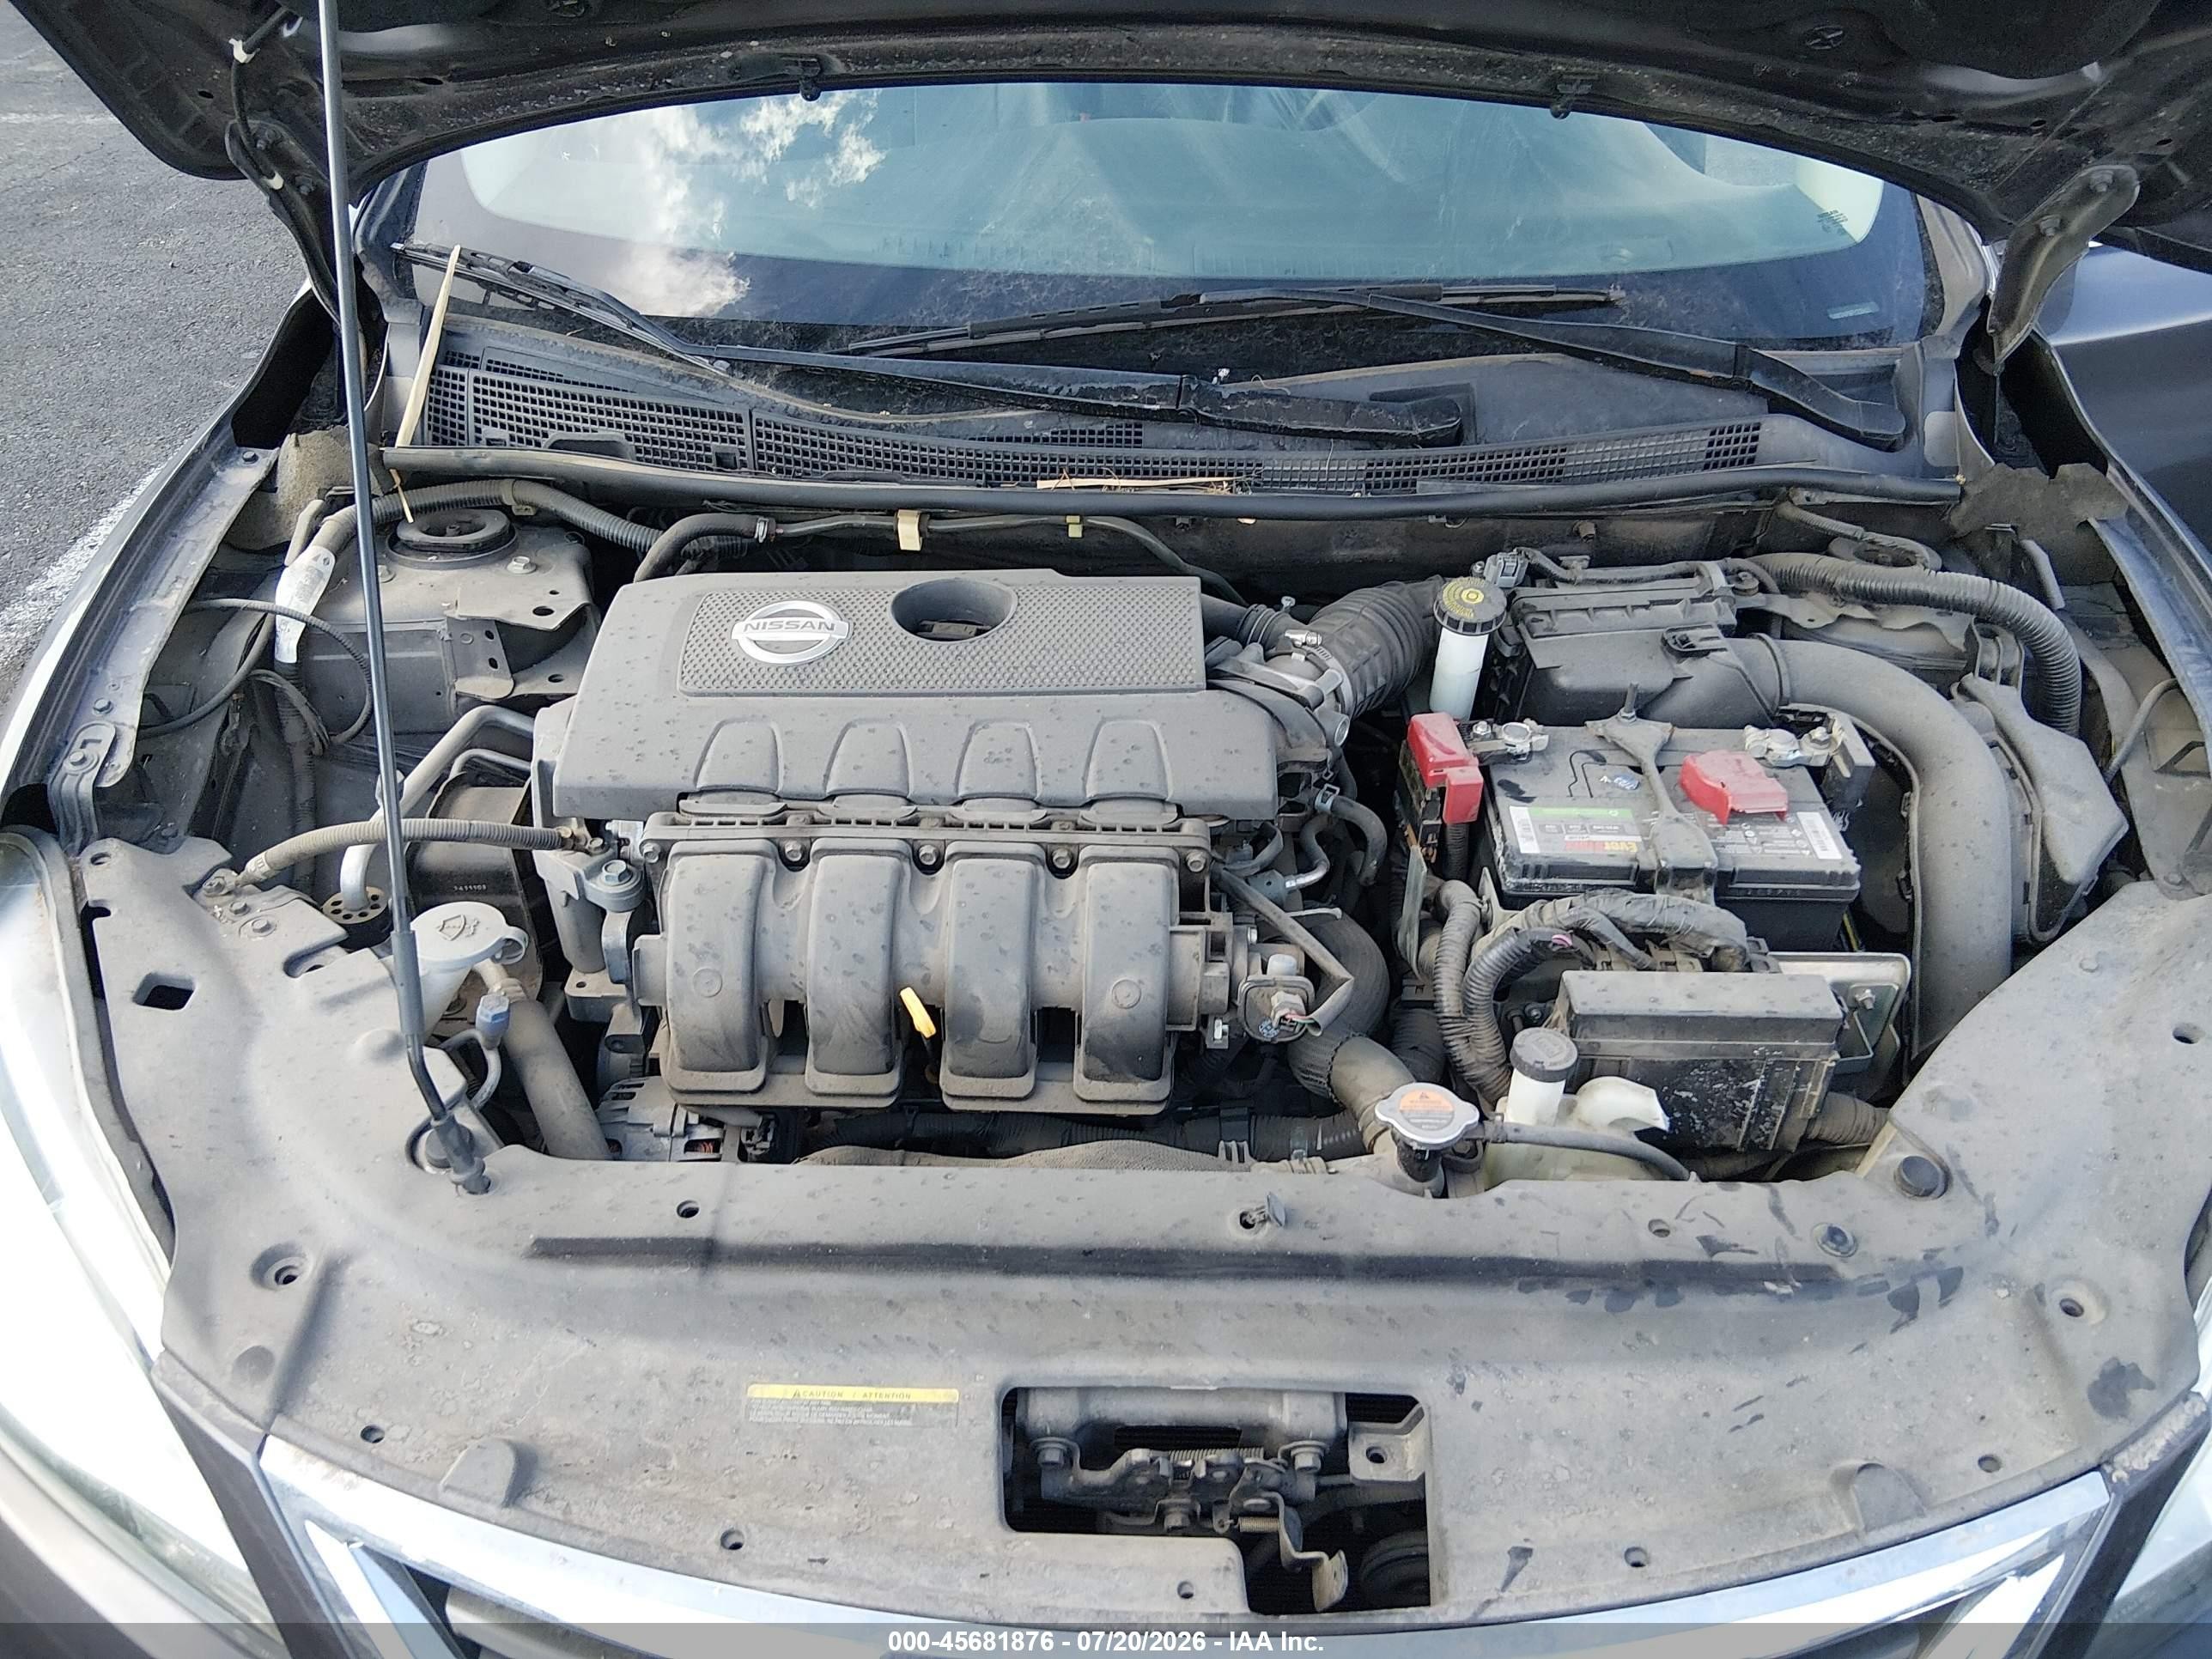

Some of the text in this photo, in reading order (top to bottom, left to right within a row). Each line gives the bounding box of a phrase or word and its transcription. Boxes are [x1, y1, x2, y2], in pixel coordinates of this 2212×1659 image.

[744, 620, 835, 631] NISSAN
[802, 1389, 843, 1398] CAUTION
[862, 1391, 911, 1400] ATTENTION
